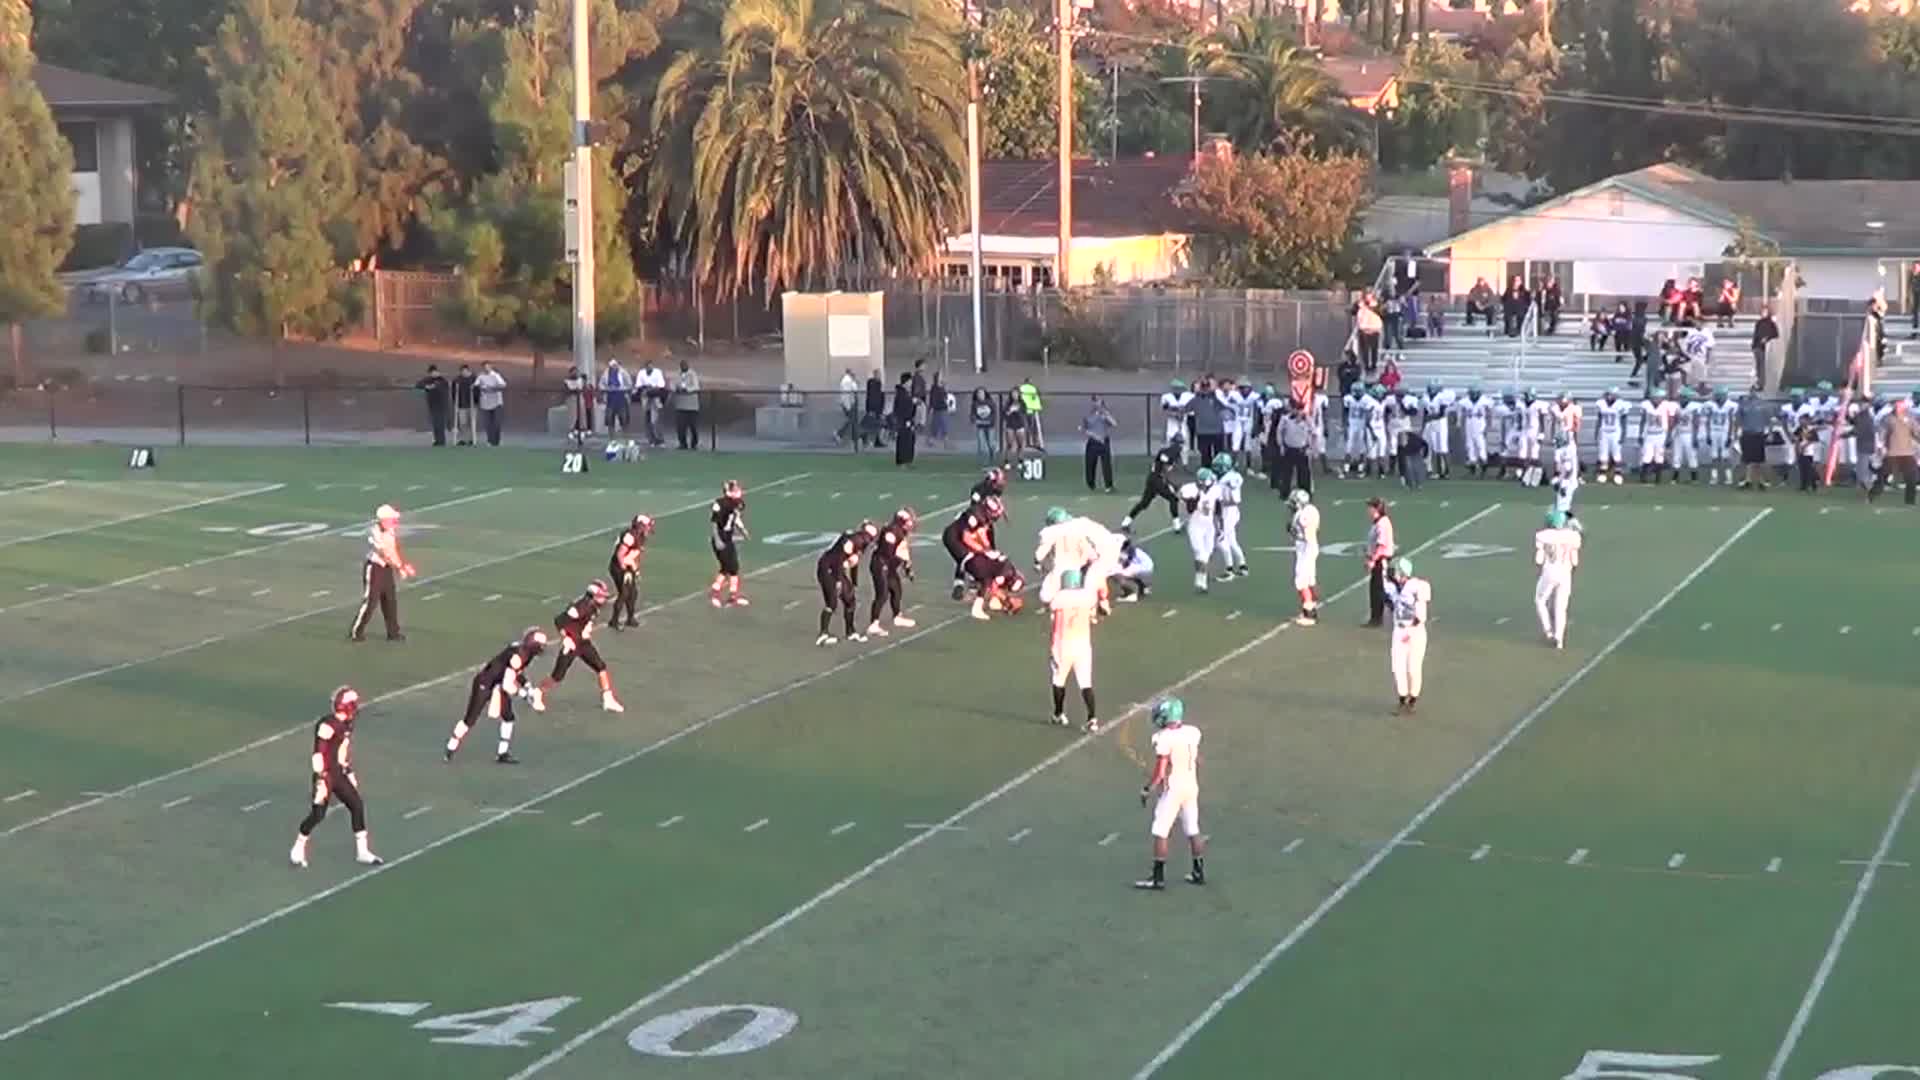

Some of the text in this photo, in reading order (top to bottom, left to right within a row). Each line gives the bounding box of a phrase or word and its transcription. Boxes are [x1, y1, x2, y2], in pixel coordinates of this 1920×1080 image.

[130, 449, 149, 467] 10
[563, 453, 582, 473] 20
[1023, 459, 1042, 480] 30
[412, 996, 799, 1057] 40
